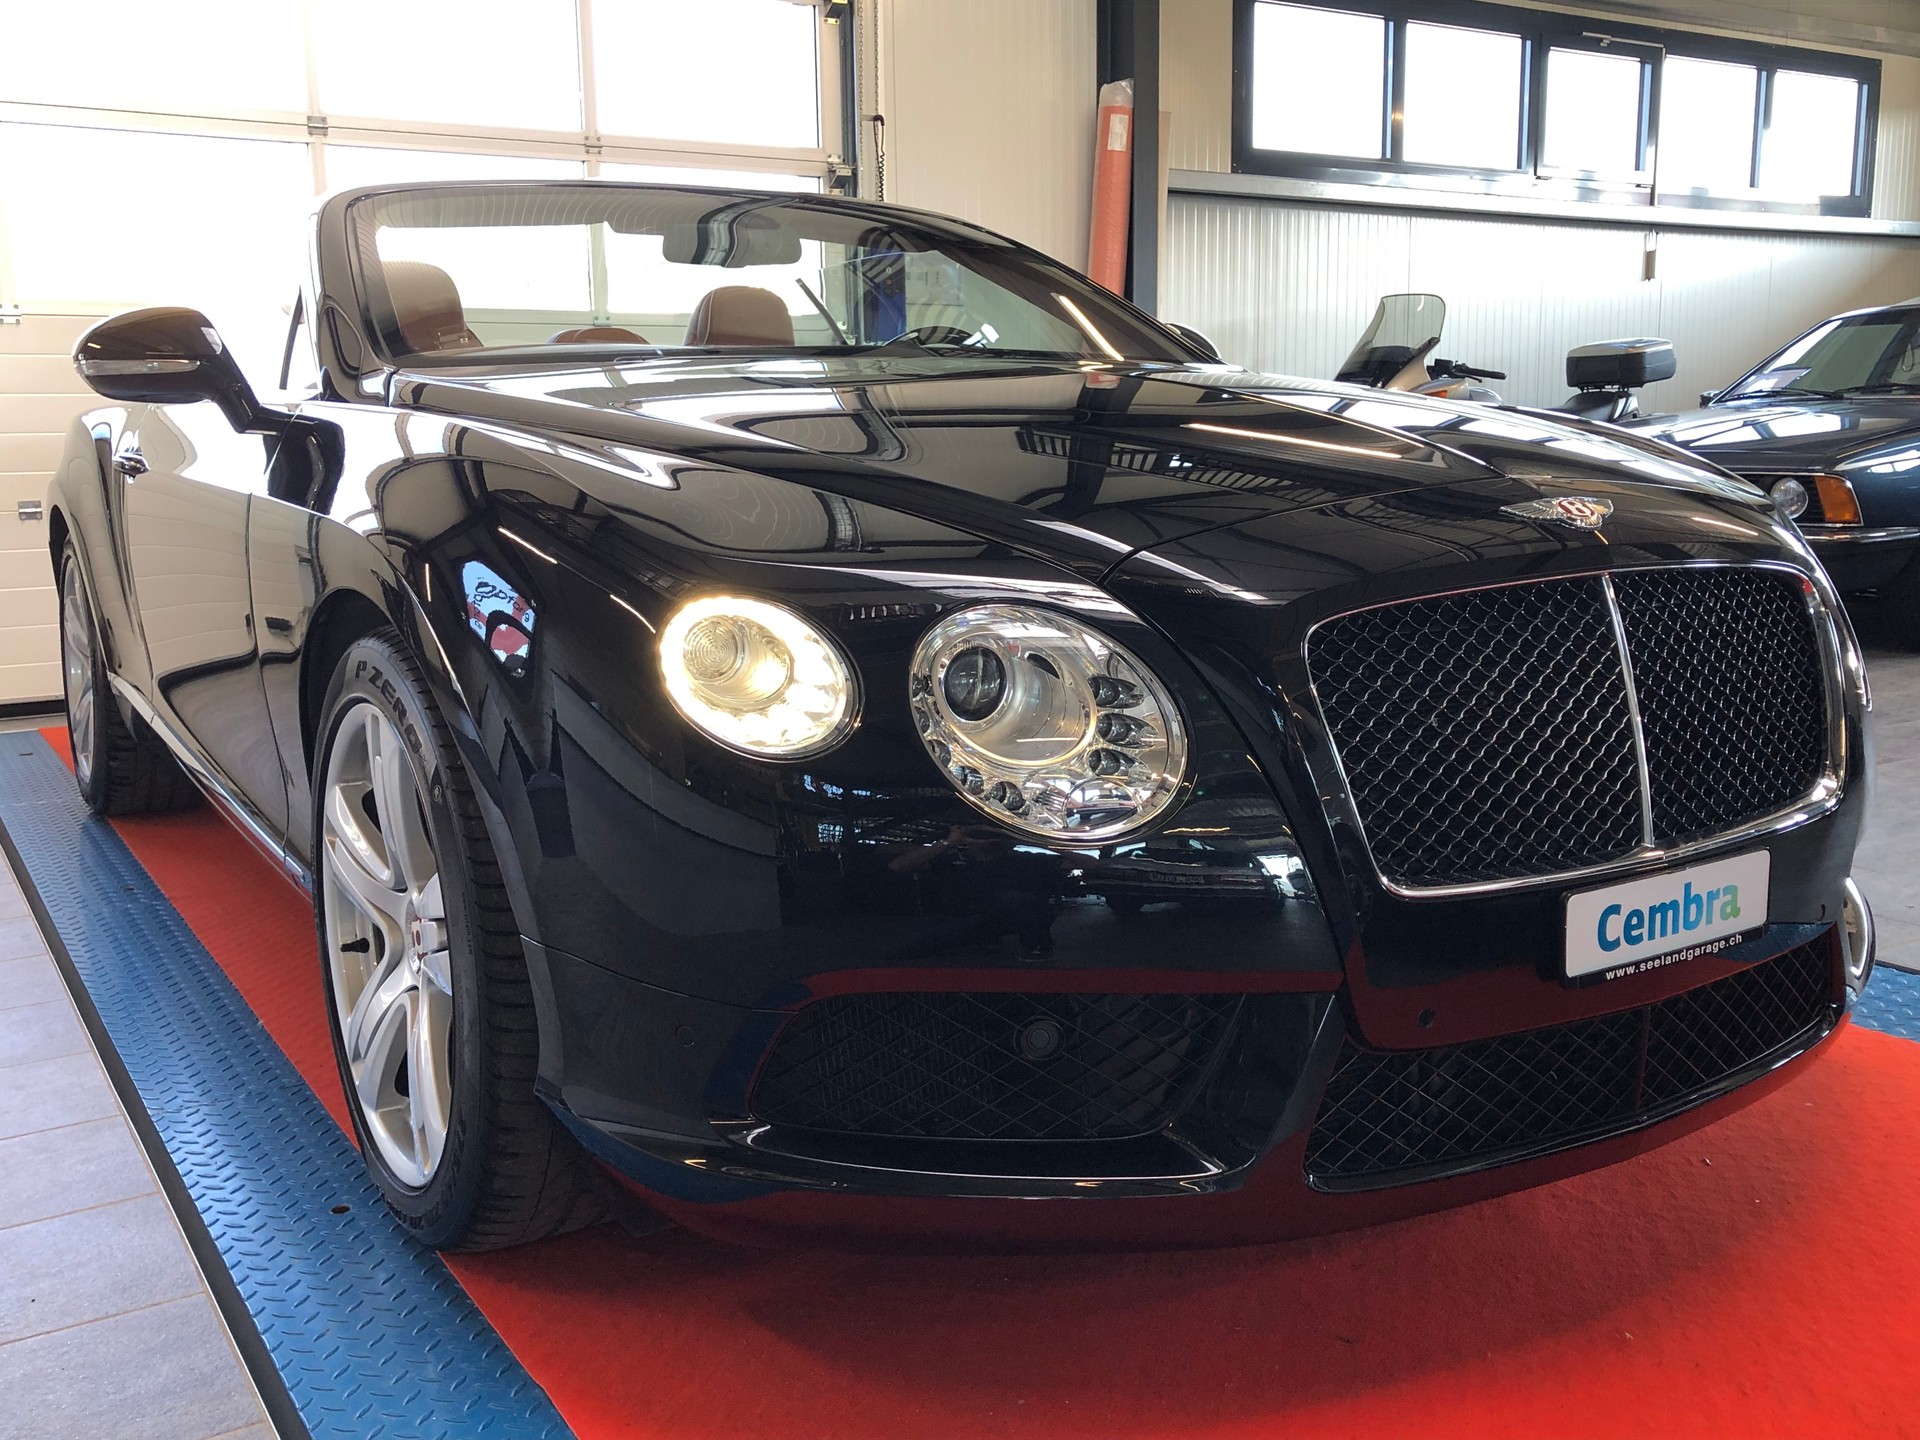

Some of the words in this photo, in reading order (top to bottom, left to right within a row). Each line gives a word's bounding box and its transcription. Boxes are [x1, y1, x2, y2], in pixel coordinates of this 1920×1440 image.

[355, 660, 368, 679] P
[367, 665, 423, 754] ZERO
[1597, 882, 1741, 953] Cembra
[1606, 933, 1743, 981] www.seelandgarage.ch
